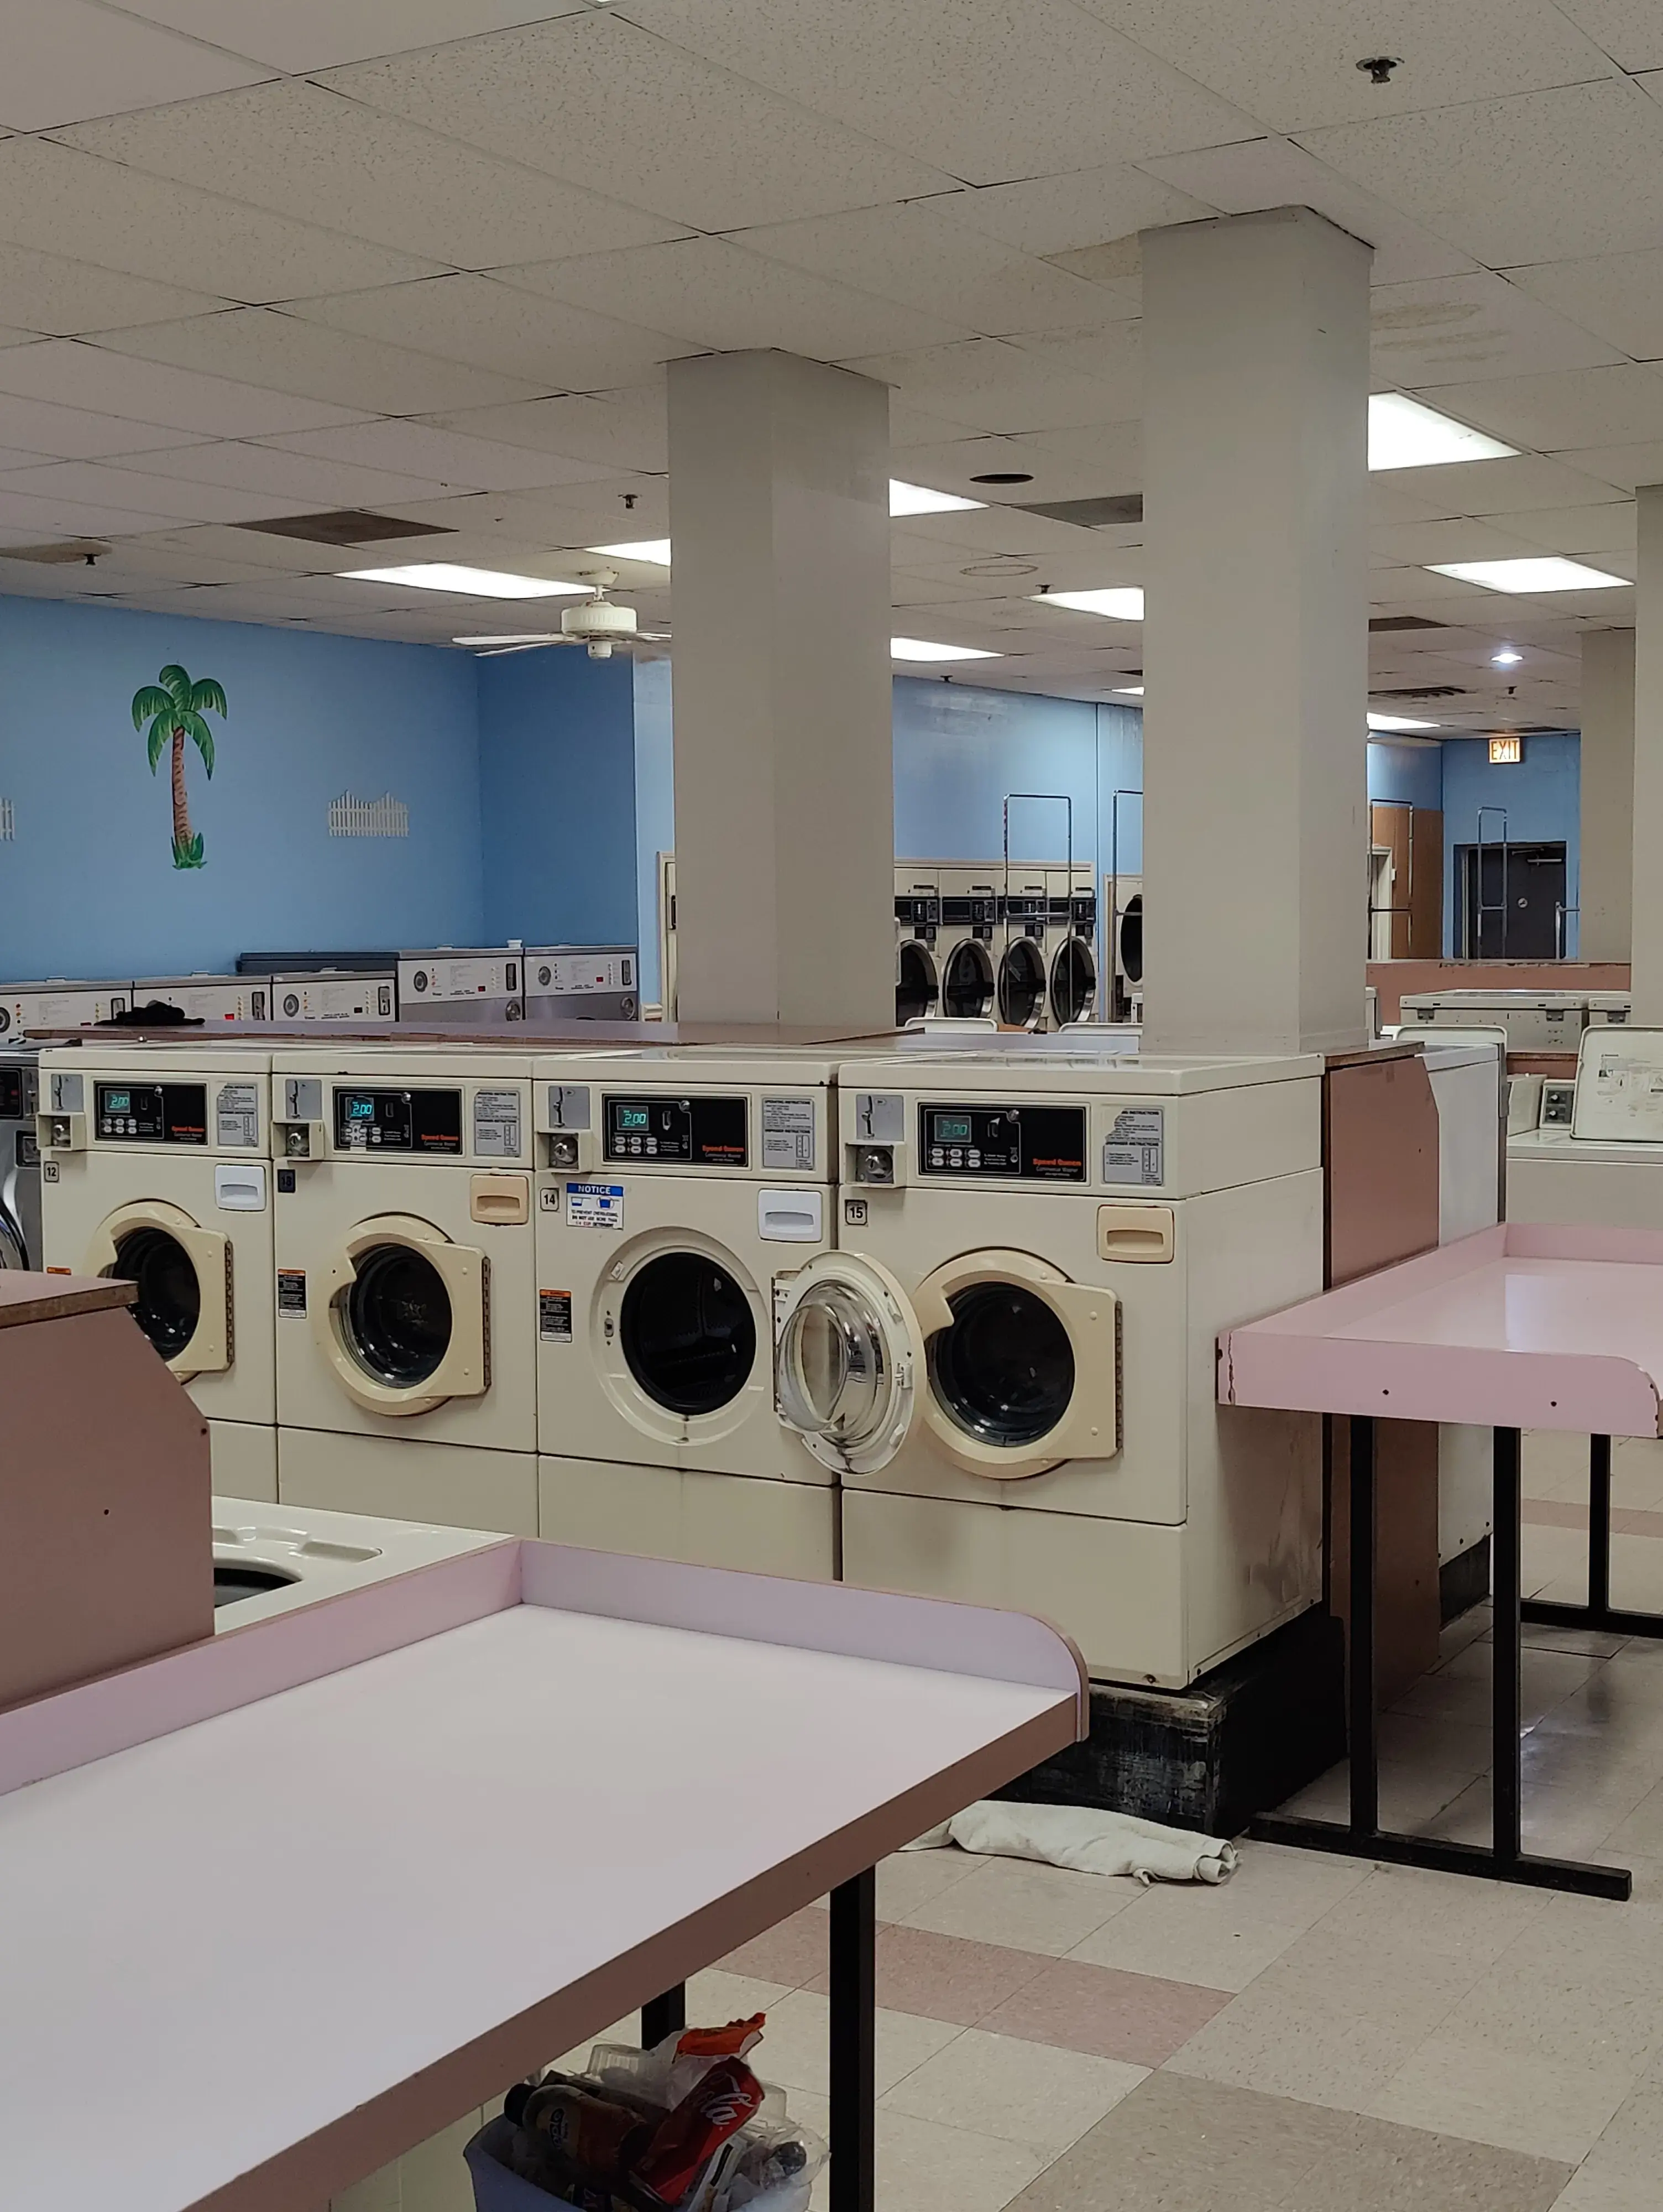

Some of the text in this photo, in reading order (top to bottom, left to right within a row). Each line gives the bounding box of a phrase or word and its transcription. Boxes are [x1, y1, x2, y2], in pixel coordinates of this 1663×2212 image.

[1491, 740, 1518, 760] EXIT
[47, 1167, 57, 1177] 12
[578, 1185, 611, 1194] NOTICE
[544, 1194, 556, 1204] 14
[849, 1206, 864, 1219] 15
